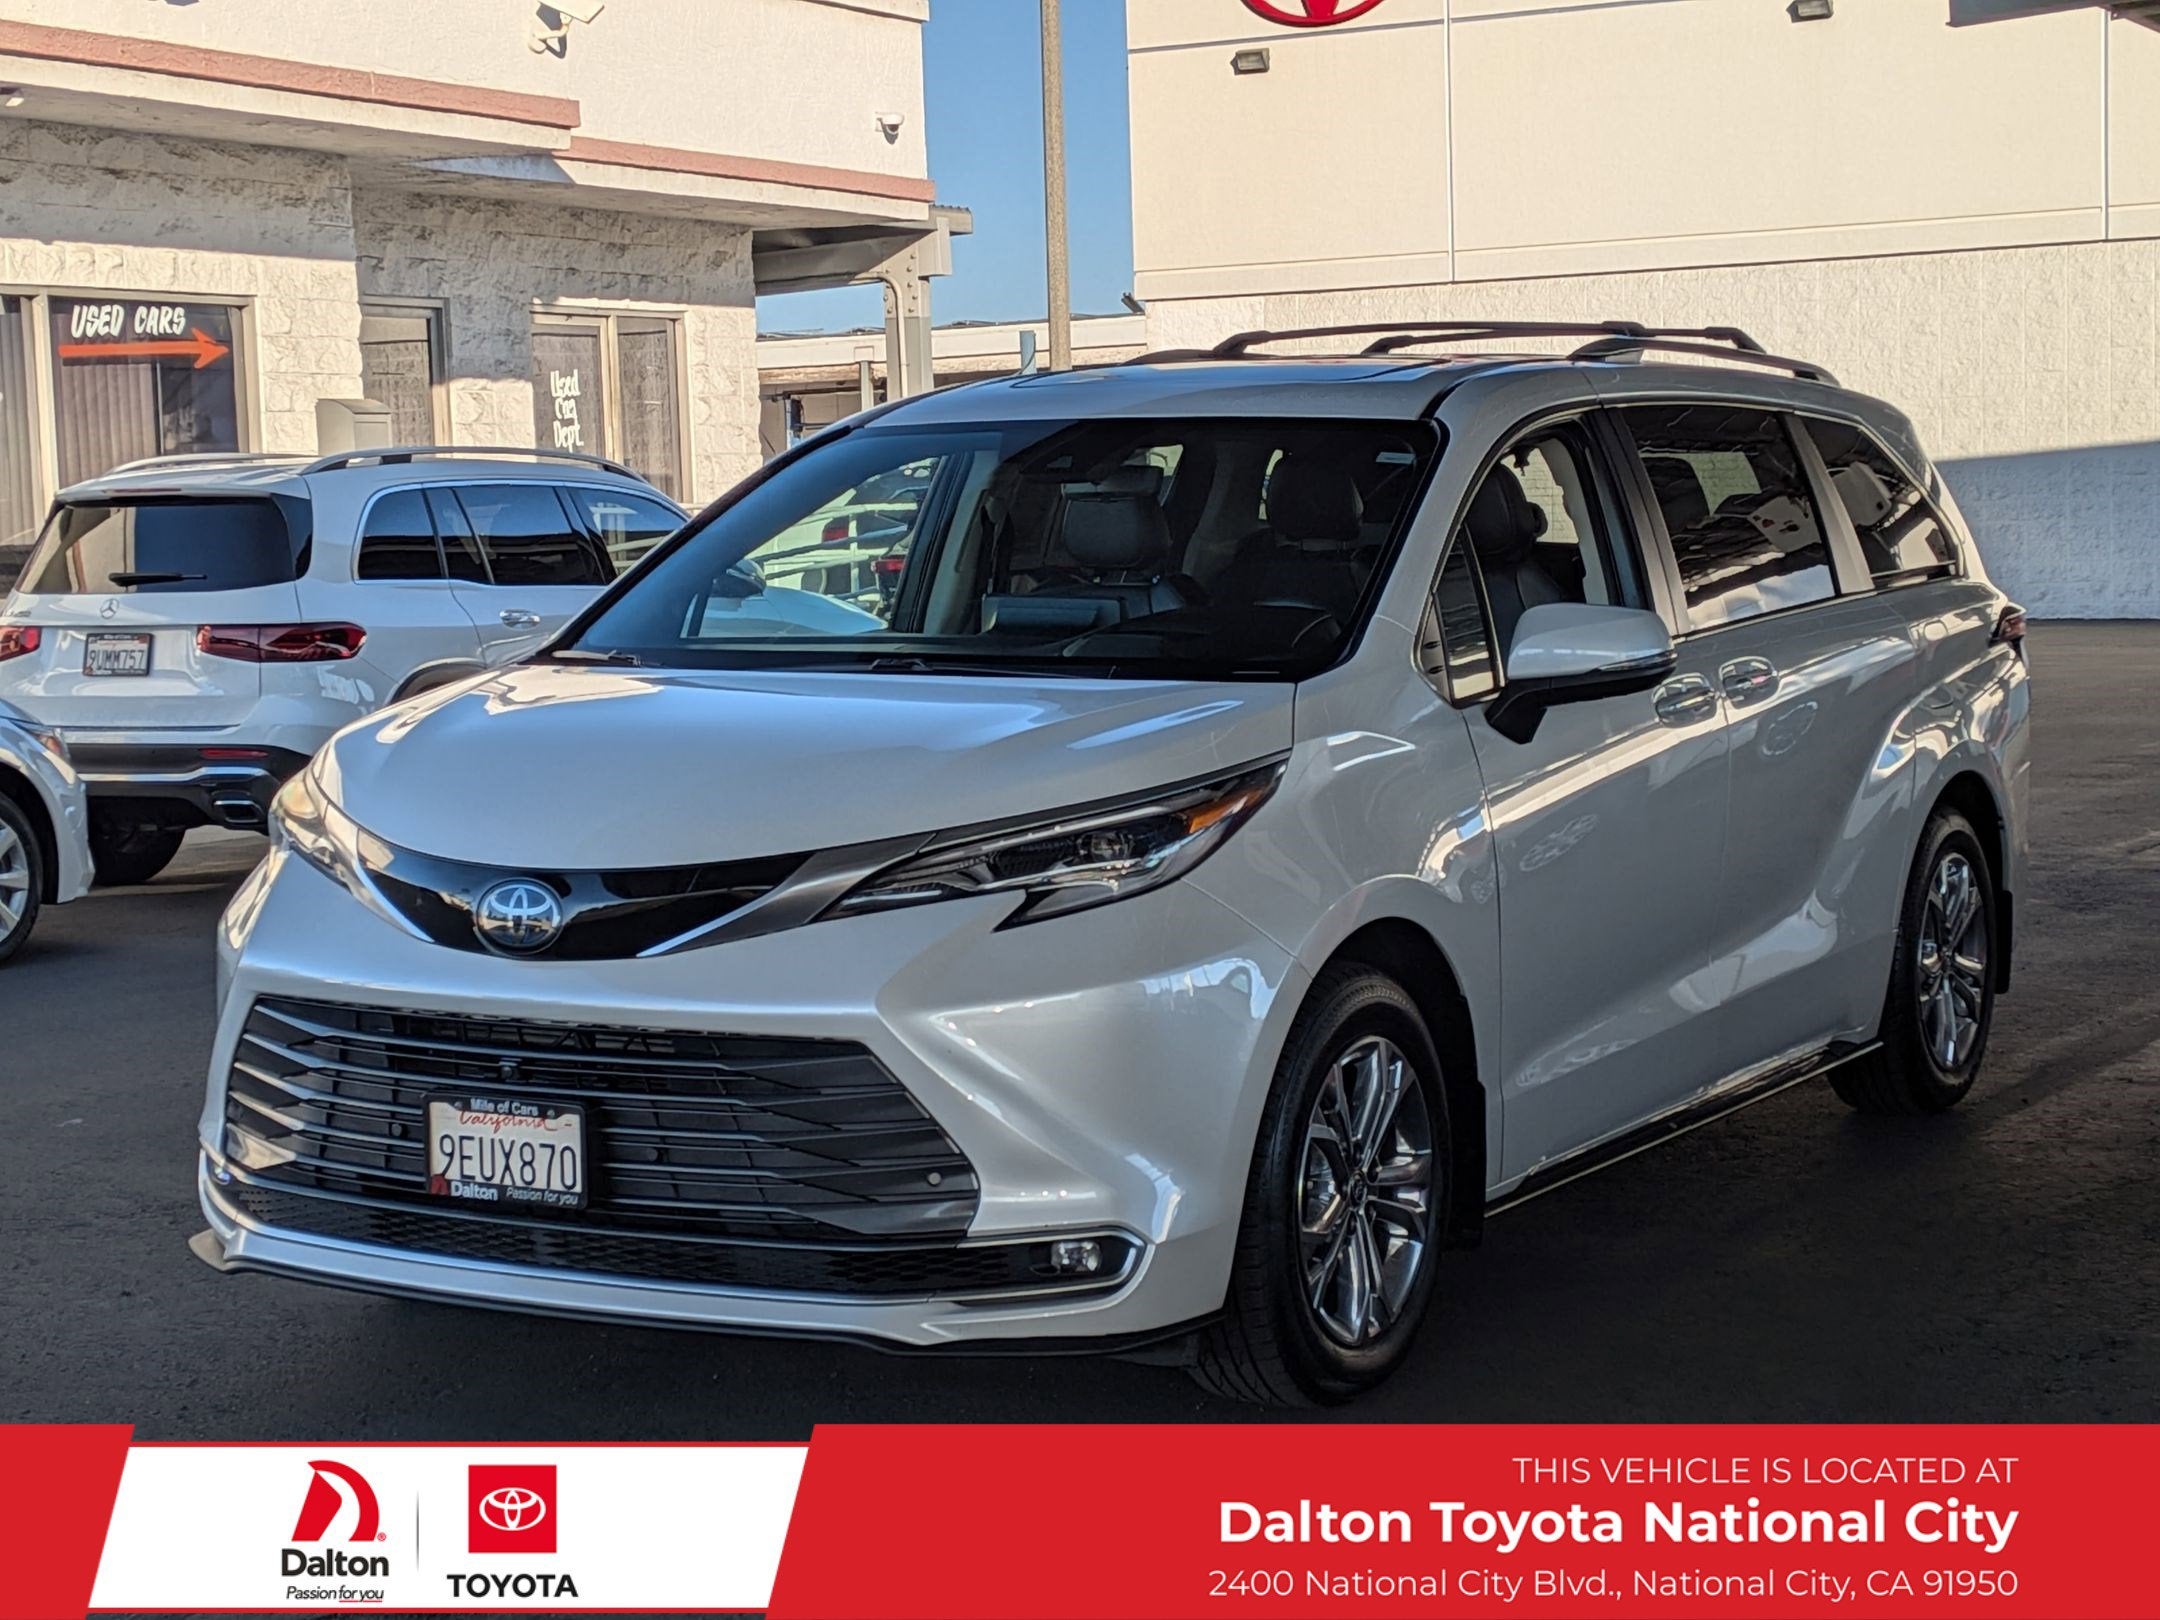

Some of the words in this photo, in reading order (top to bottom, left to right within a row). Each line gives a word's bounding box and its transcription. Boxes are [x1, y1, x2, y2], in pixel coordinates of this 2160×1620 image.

[71, 305, 125, 338] USED
[134, 305, 186, 336] CARS
[550, 369, 581, 398] Used
[470, 1098, 495, 1112] Mile
[497, 1101, 511, 1113] of
[511, 1101, 539, 1116] Cars
[439, 1133, 577, 1191] 9EUX870
[451, 1181, 498, 1201] Dalton
[506, 1187, 542, 1201] Passion
[543, 1189, 558, 1202] for
[558, 1193, 579, 1207] you
